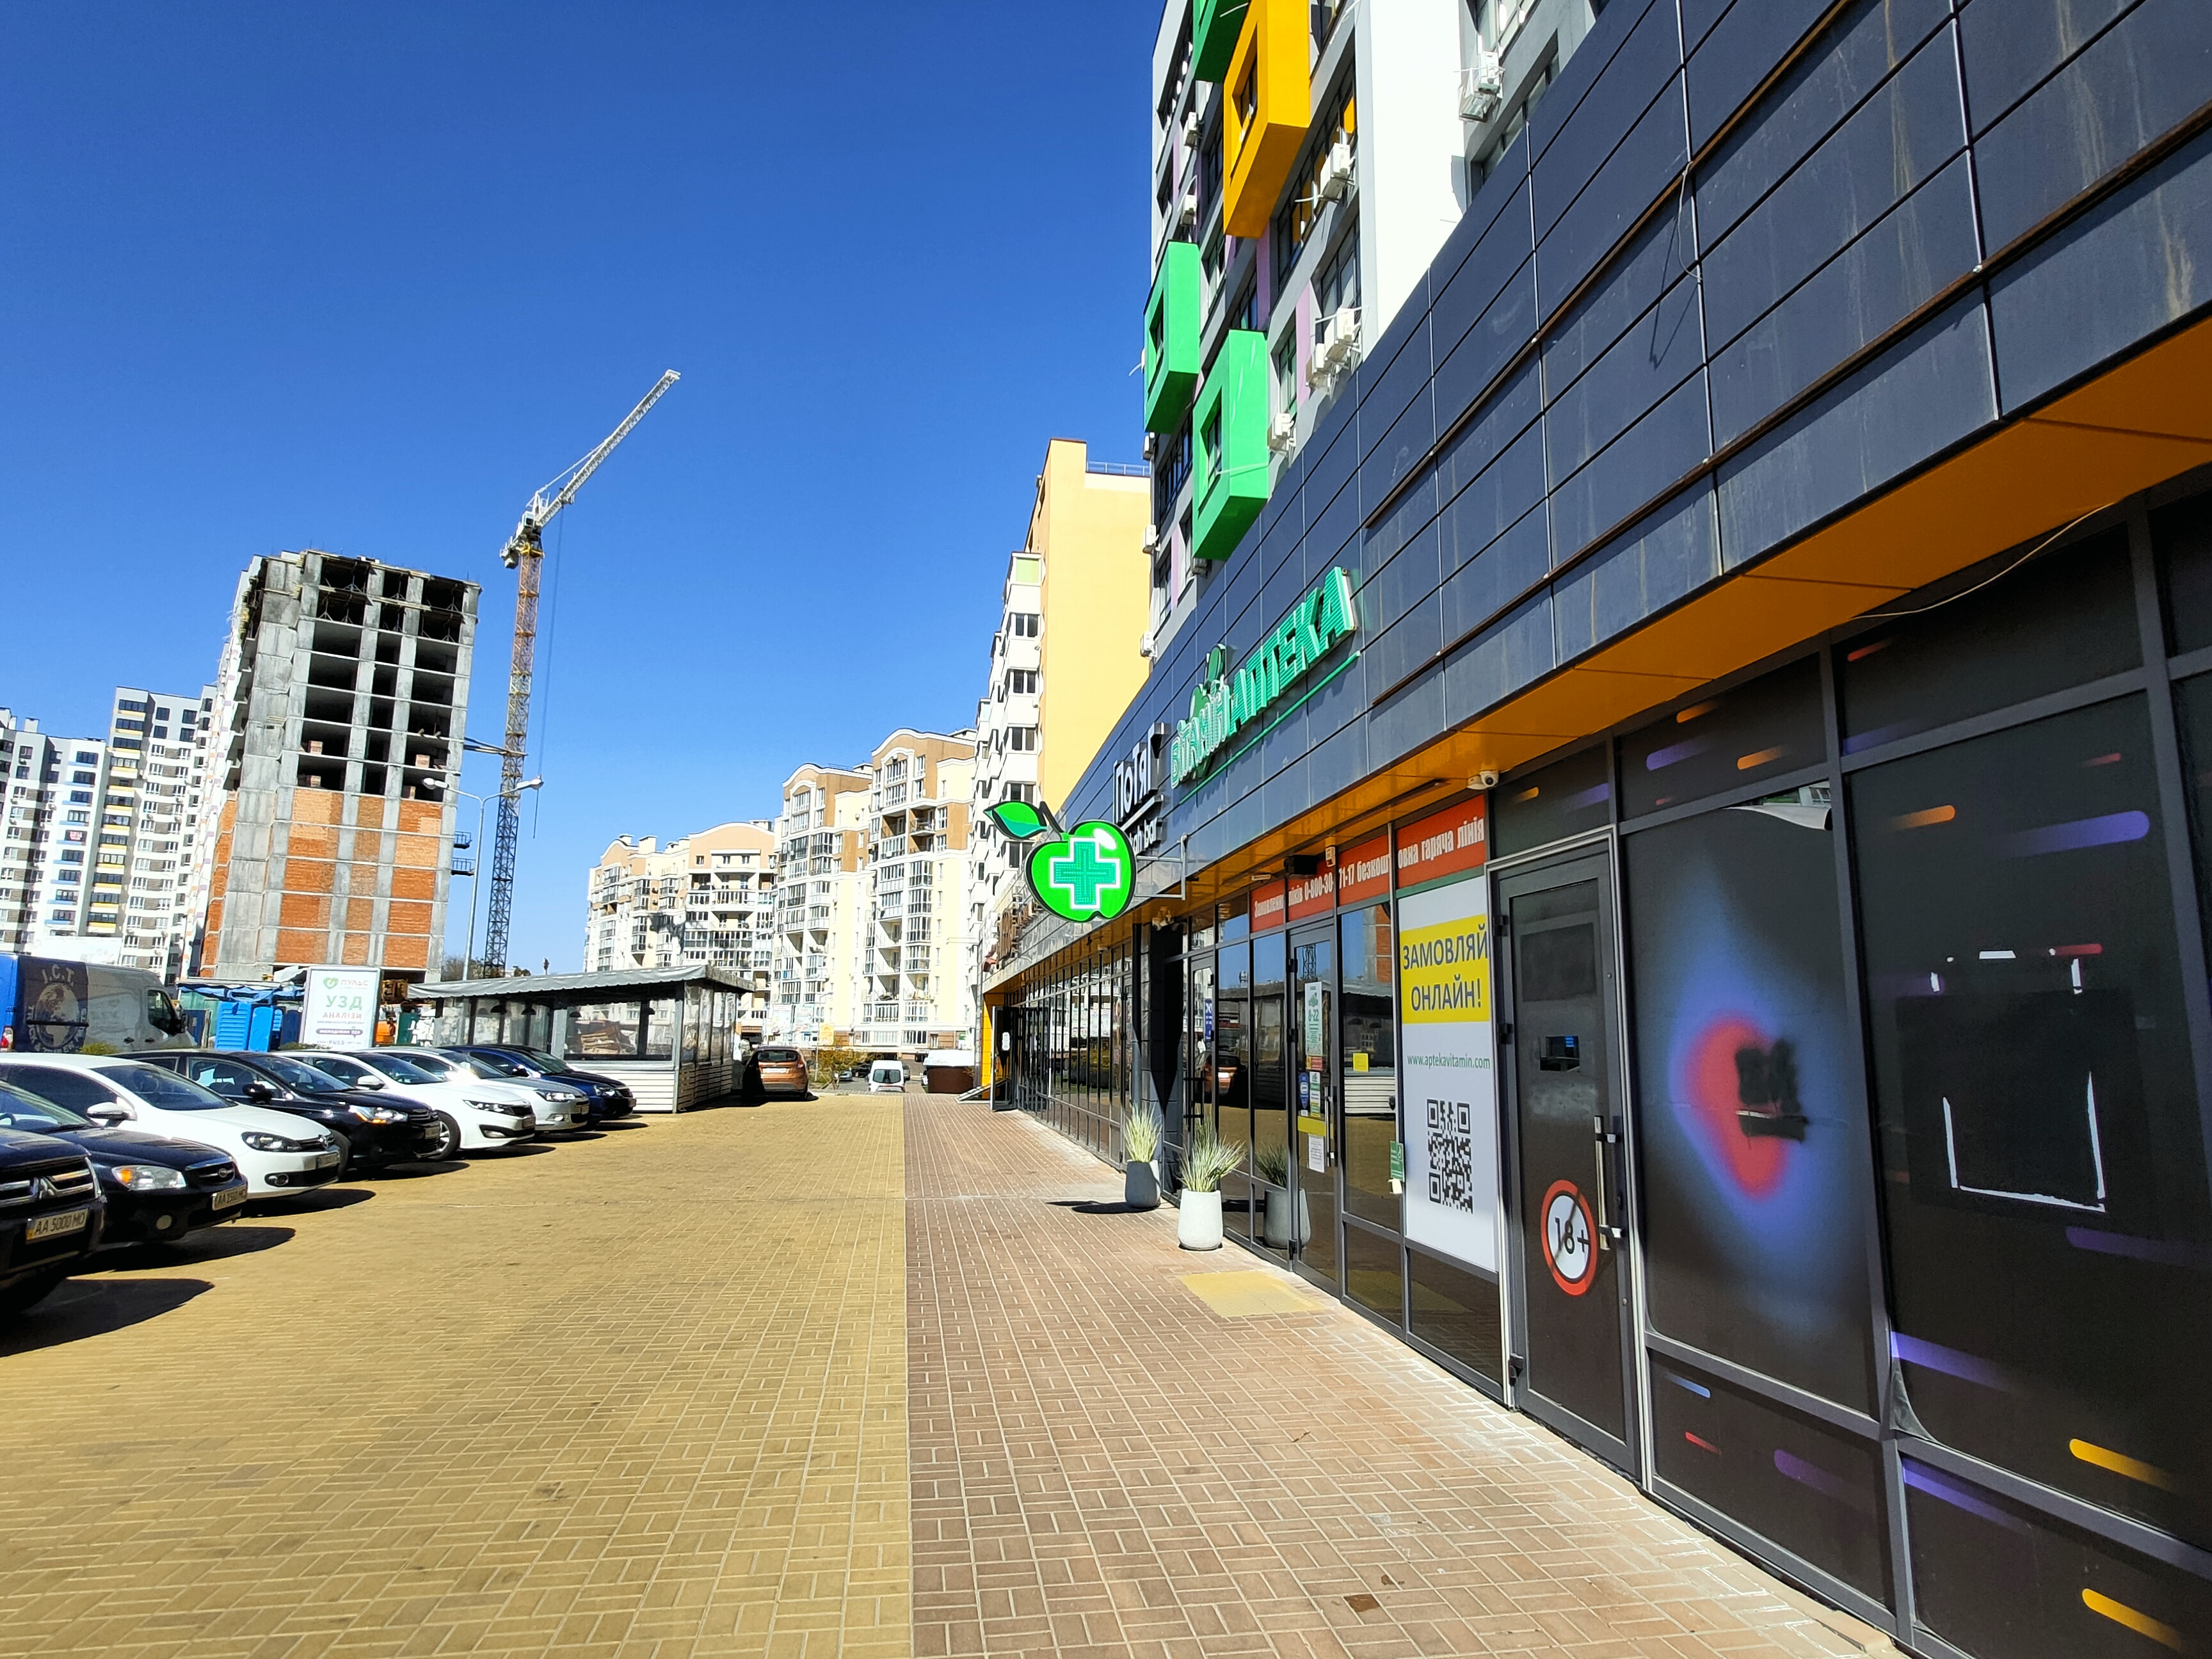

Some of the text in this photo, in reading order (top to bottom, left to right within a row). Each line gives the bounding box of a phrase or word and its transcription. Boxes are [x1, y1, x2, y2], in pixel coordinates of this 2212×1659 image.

[1228, 566, 1356, 737] АПТЕКА
[1422, 830, 1454, 861] гаряча
[1457, 817, 1484, 849] лінія
[1402, 923, 1488, 970] ЗАМОВЛЯЙ
[326, 995, 362, 1011] УЗД
[1411, 974, 1481, 1011] ОНЛАЙН!
[1407, 1052, 1491, 1070] www.aptekavitamin.com
[1554, 1217, 1591, 1254] 18+
